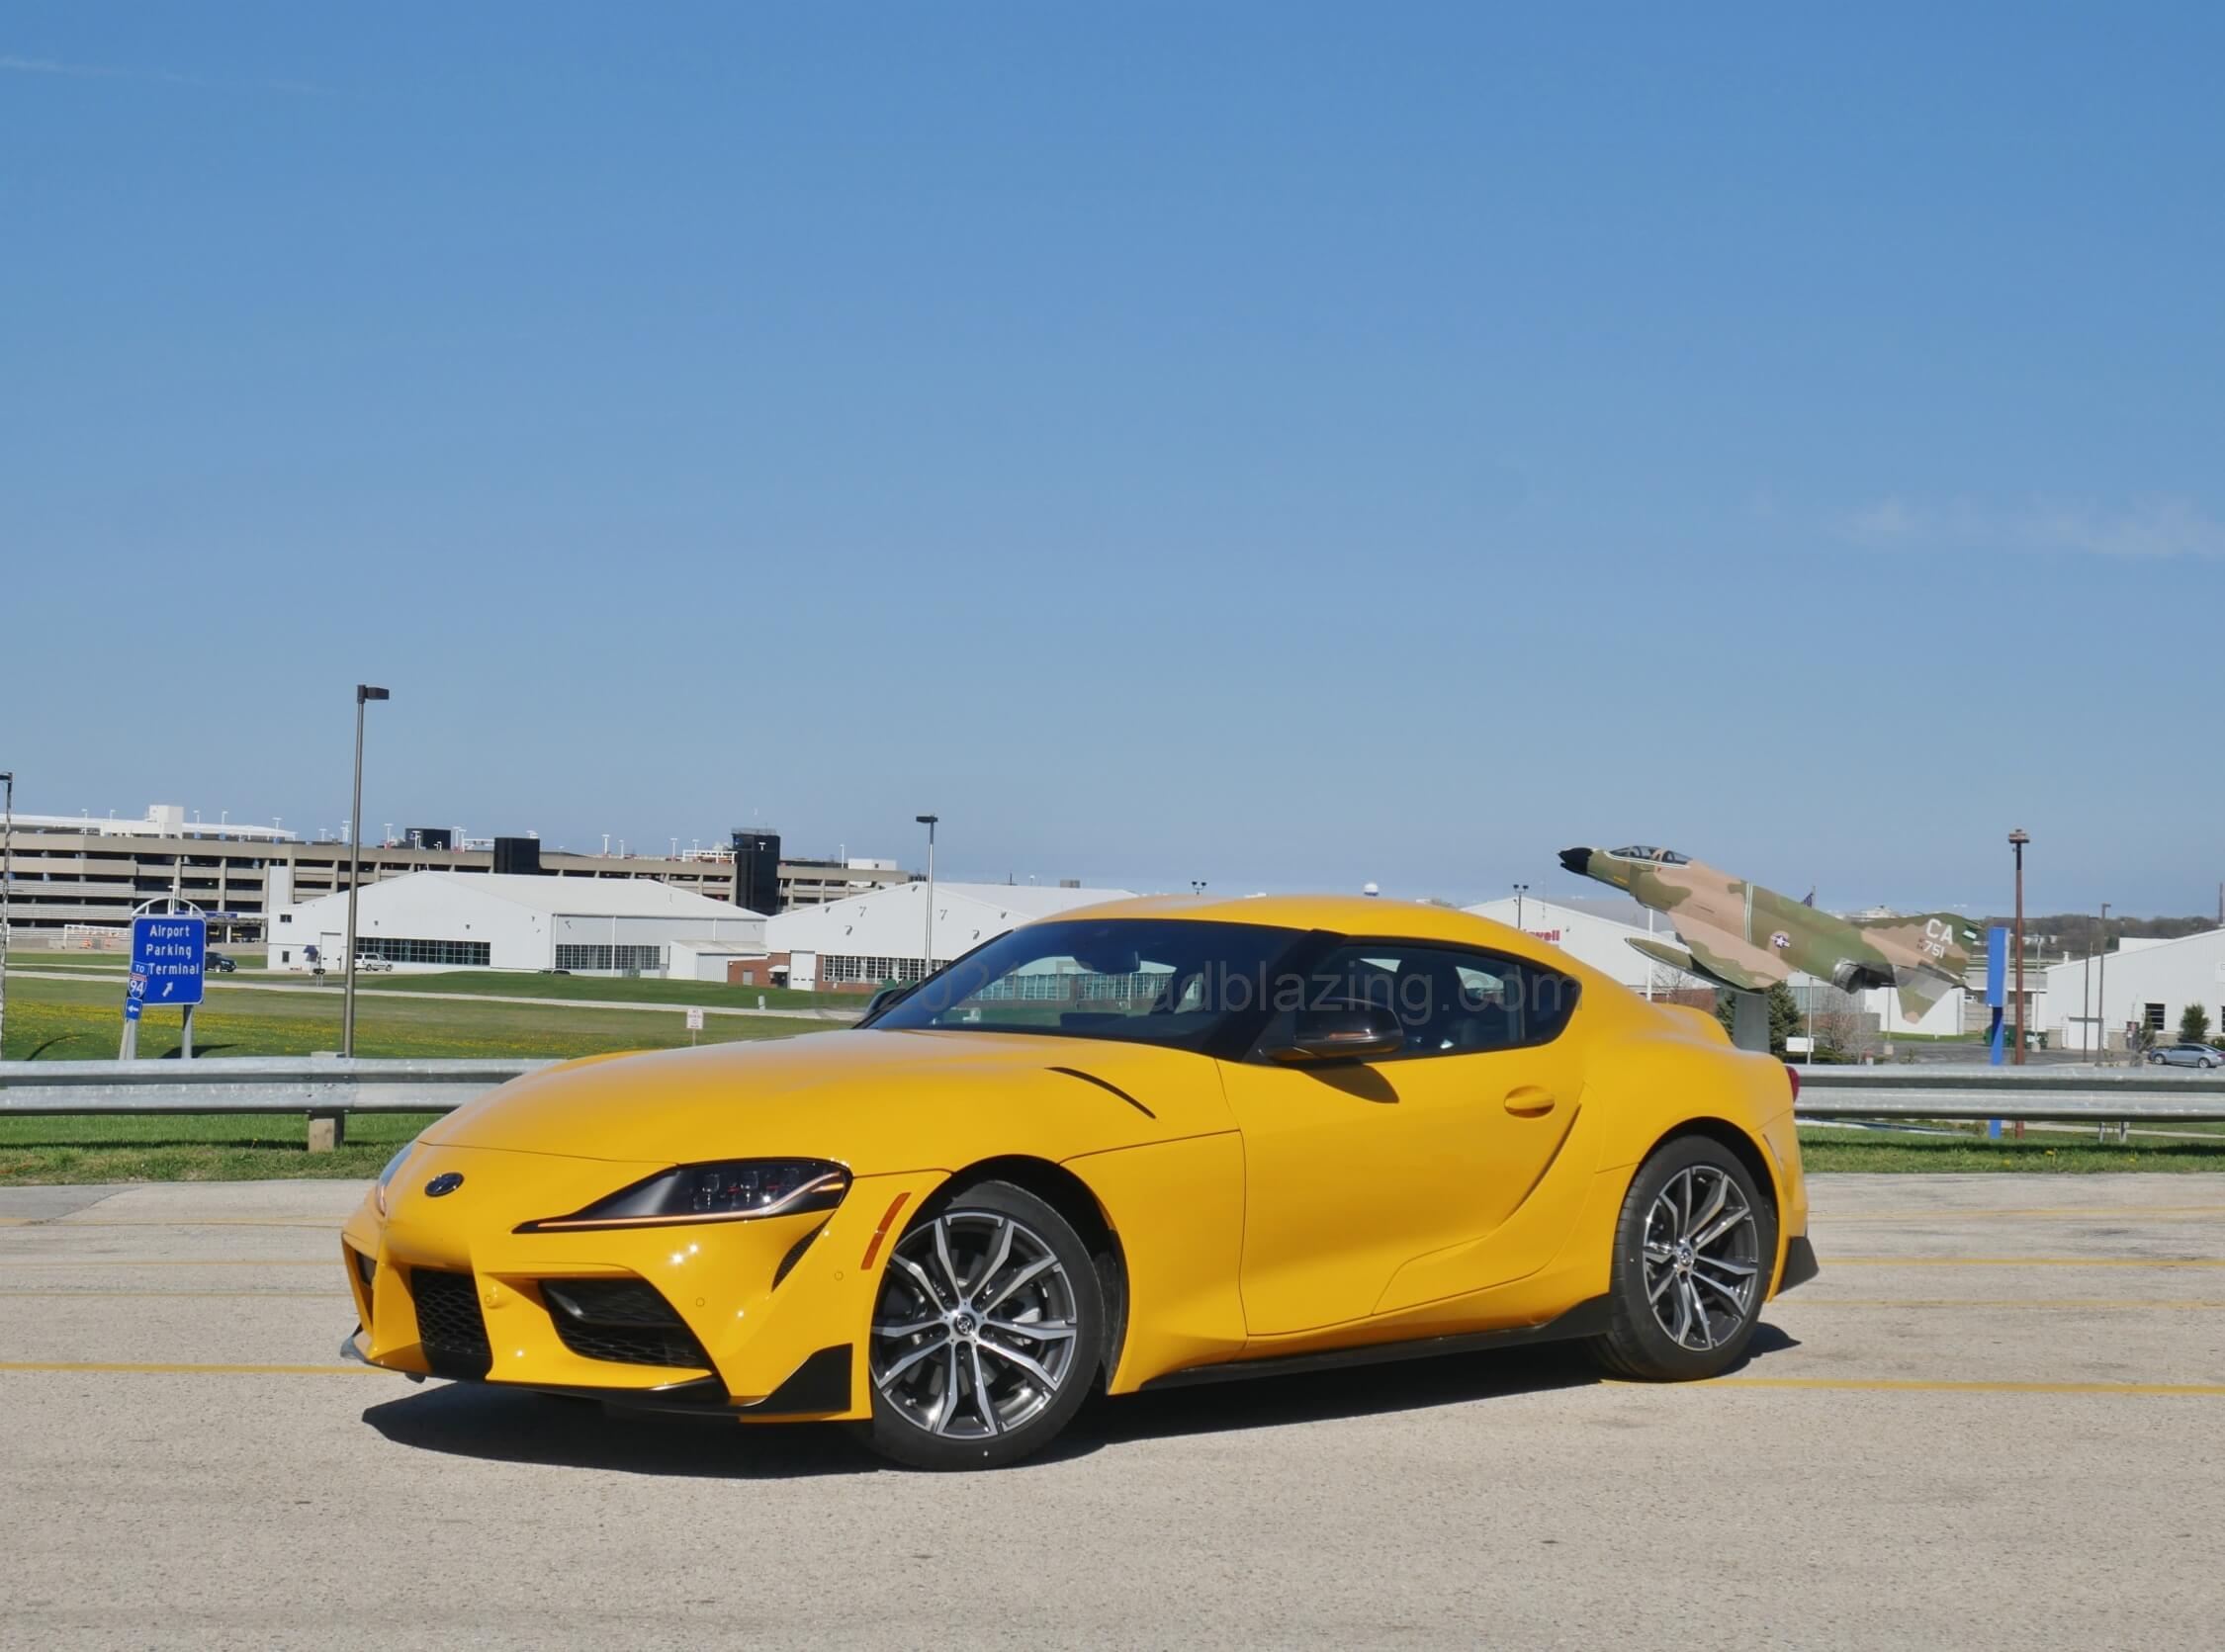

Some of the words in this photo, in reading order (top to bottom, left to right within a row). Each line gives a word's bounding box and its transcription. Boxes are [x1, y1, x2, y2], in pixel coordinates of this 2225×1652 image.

[149, 924, 190, 939] Airport
[1926, 917, 1953, 945] CA
[145, 944, 192, 960] Parking
[1923, 940, 1945, 959] 751
[135, 964, 145, 973] TO
[149, 962, 200, 975] Terminal
[130, 980, 143, 993] 94
